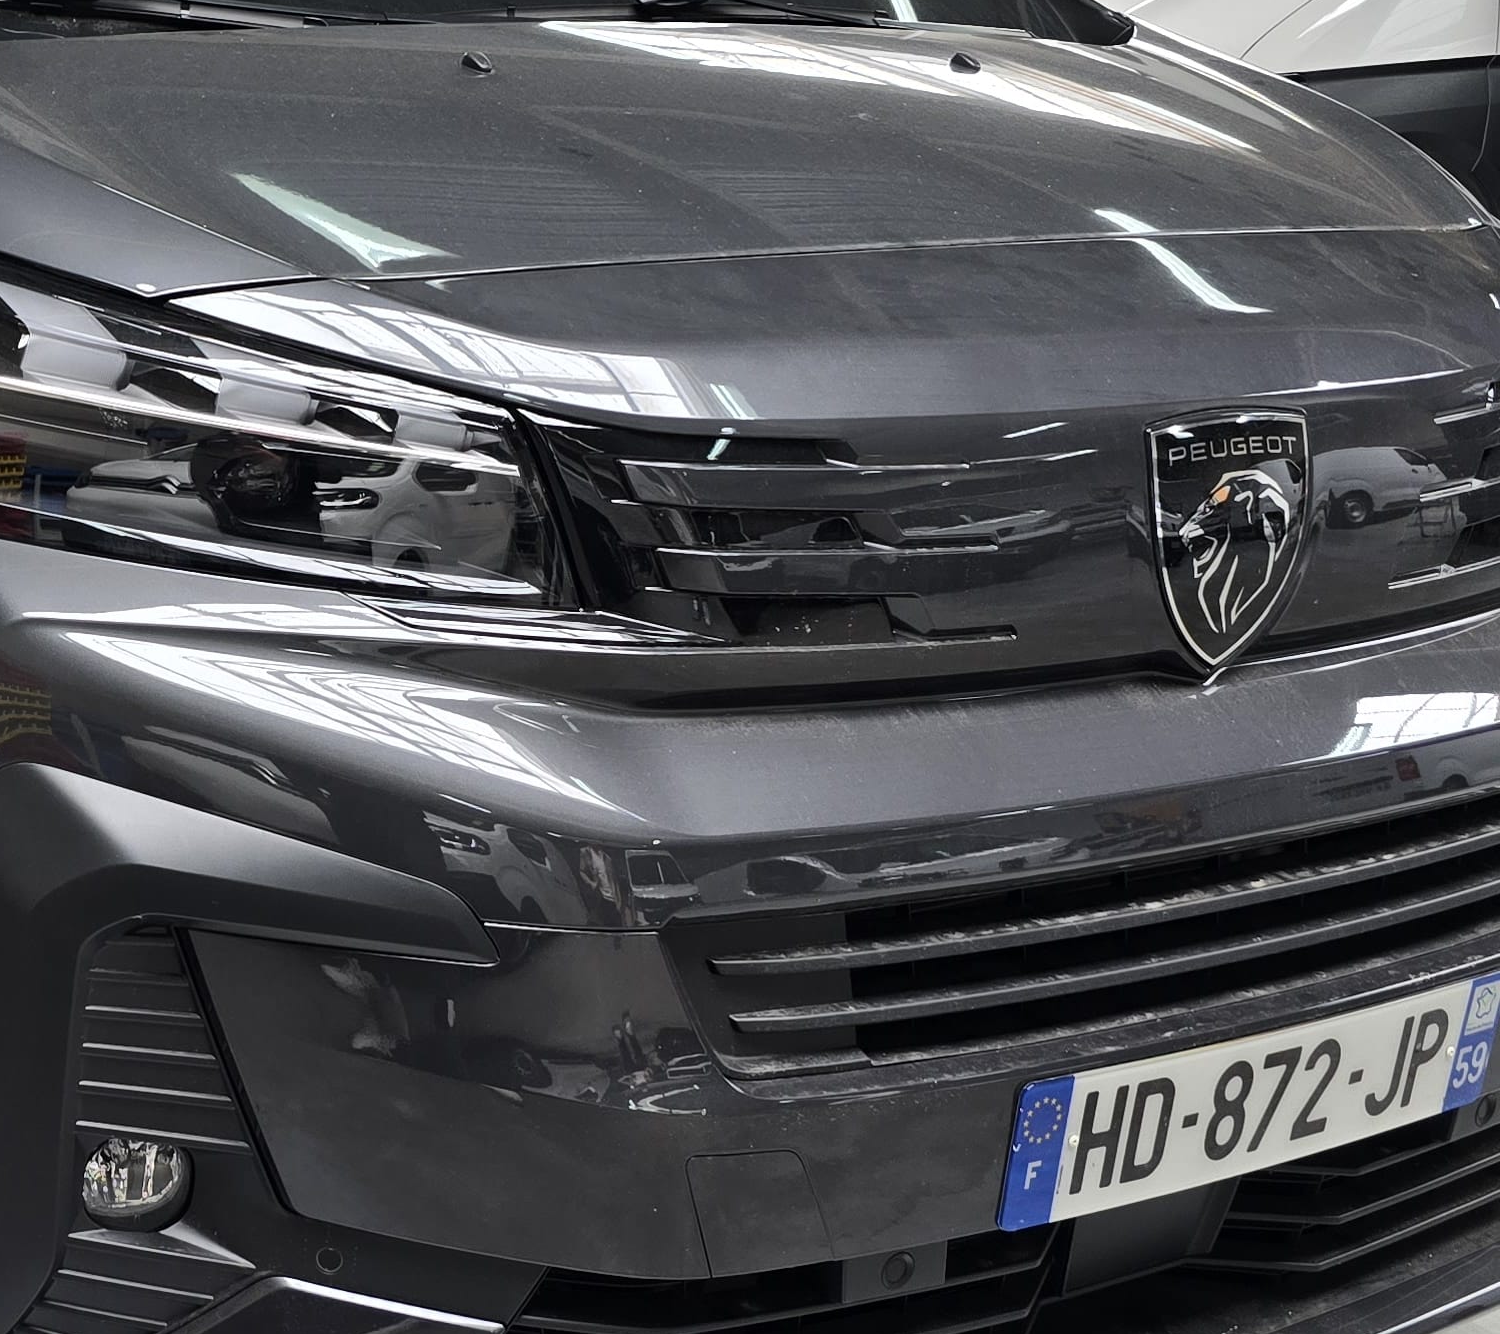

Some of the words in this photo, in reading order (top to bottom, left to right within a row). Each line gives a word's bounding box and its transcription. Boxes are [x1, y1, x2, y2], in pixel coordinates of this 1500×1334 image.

[1168, 435, 1298, 467] PEUGEOT
[1452, 1040, 1488, 1089] 59
[1068, 1008, 1450, 1196] HD-872-JP
[1023, 1160, 1042, 1191] F
